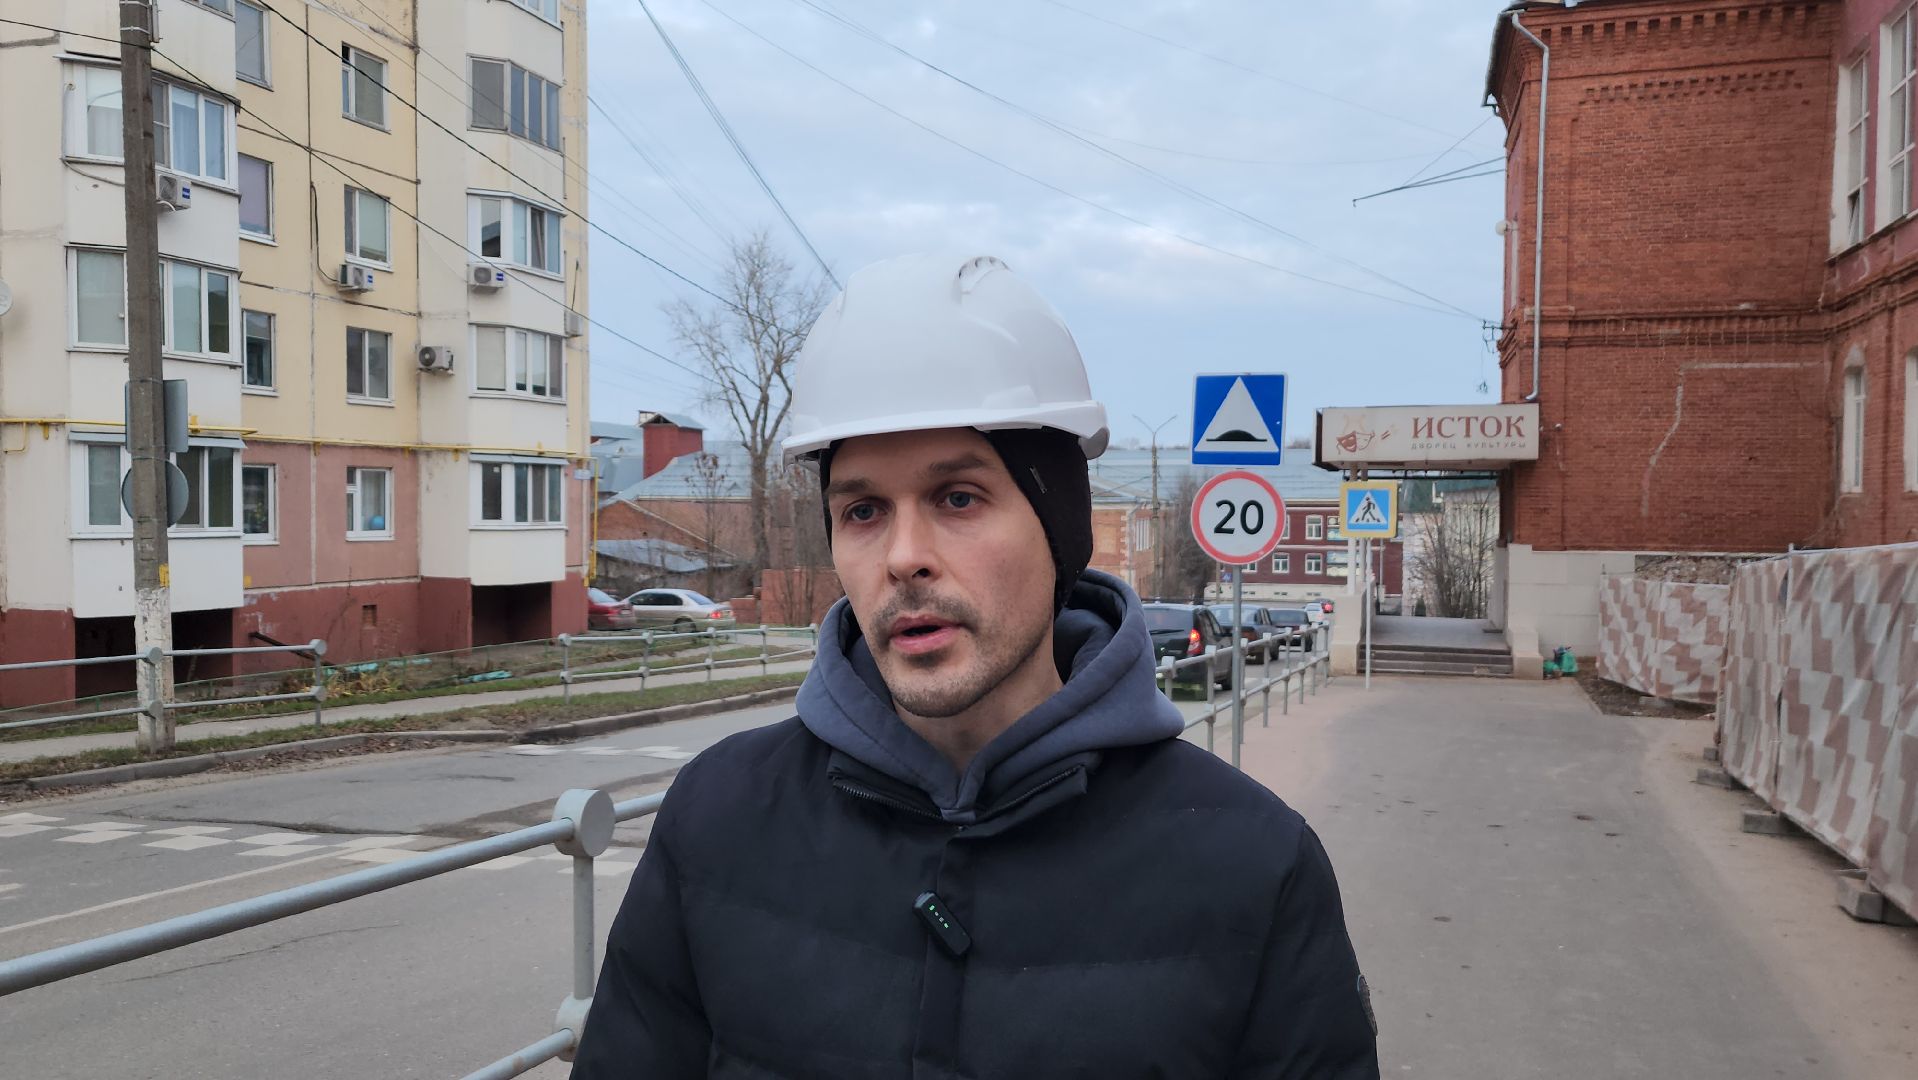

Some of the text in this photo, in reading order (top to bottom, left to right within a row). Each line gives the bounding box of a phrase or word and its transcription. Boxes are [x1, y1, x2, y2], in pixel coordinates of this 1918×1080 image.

[1412, 415, 1526, 439] ИСТОК
[1411, 440, 1526, 450] ДВОРЕЦ КУЛЬТУРЫ
[1213, 499, 1264, 535] 20
